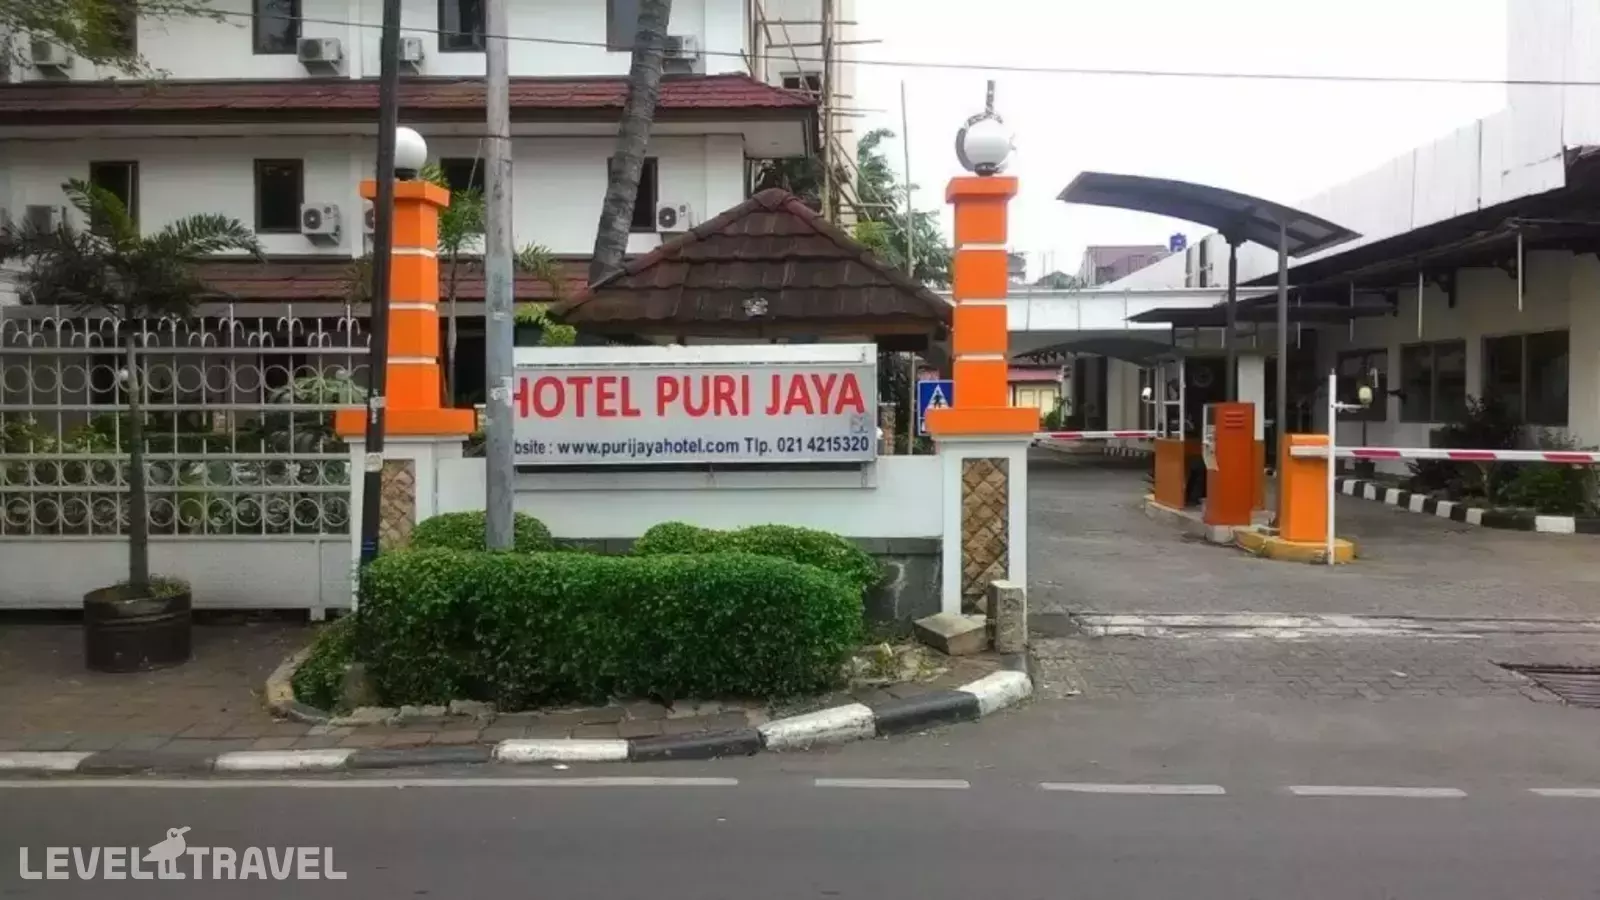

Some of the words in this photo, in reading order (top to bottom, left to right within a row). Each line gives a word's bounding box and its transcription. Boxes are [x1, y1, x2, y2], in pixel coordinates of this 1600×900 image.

[513, 376, 641, 418] HOTEL
[656, 375, 750, 417] PURI
[765, 373, 866, 416] JAYA
[557, 437, 739, 457] www.purijayahotel.com
[744, 437, 773, 456] Tlp.
[777, 436, 803, 452] 021
[807, 435, 870, 452] 4215320
